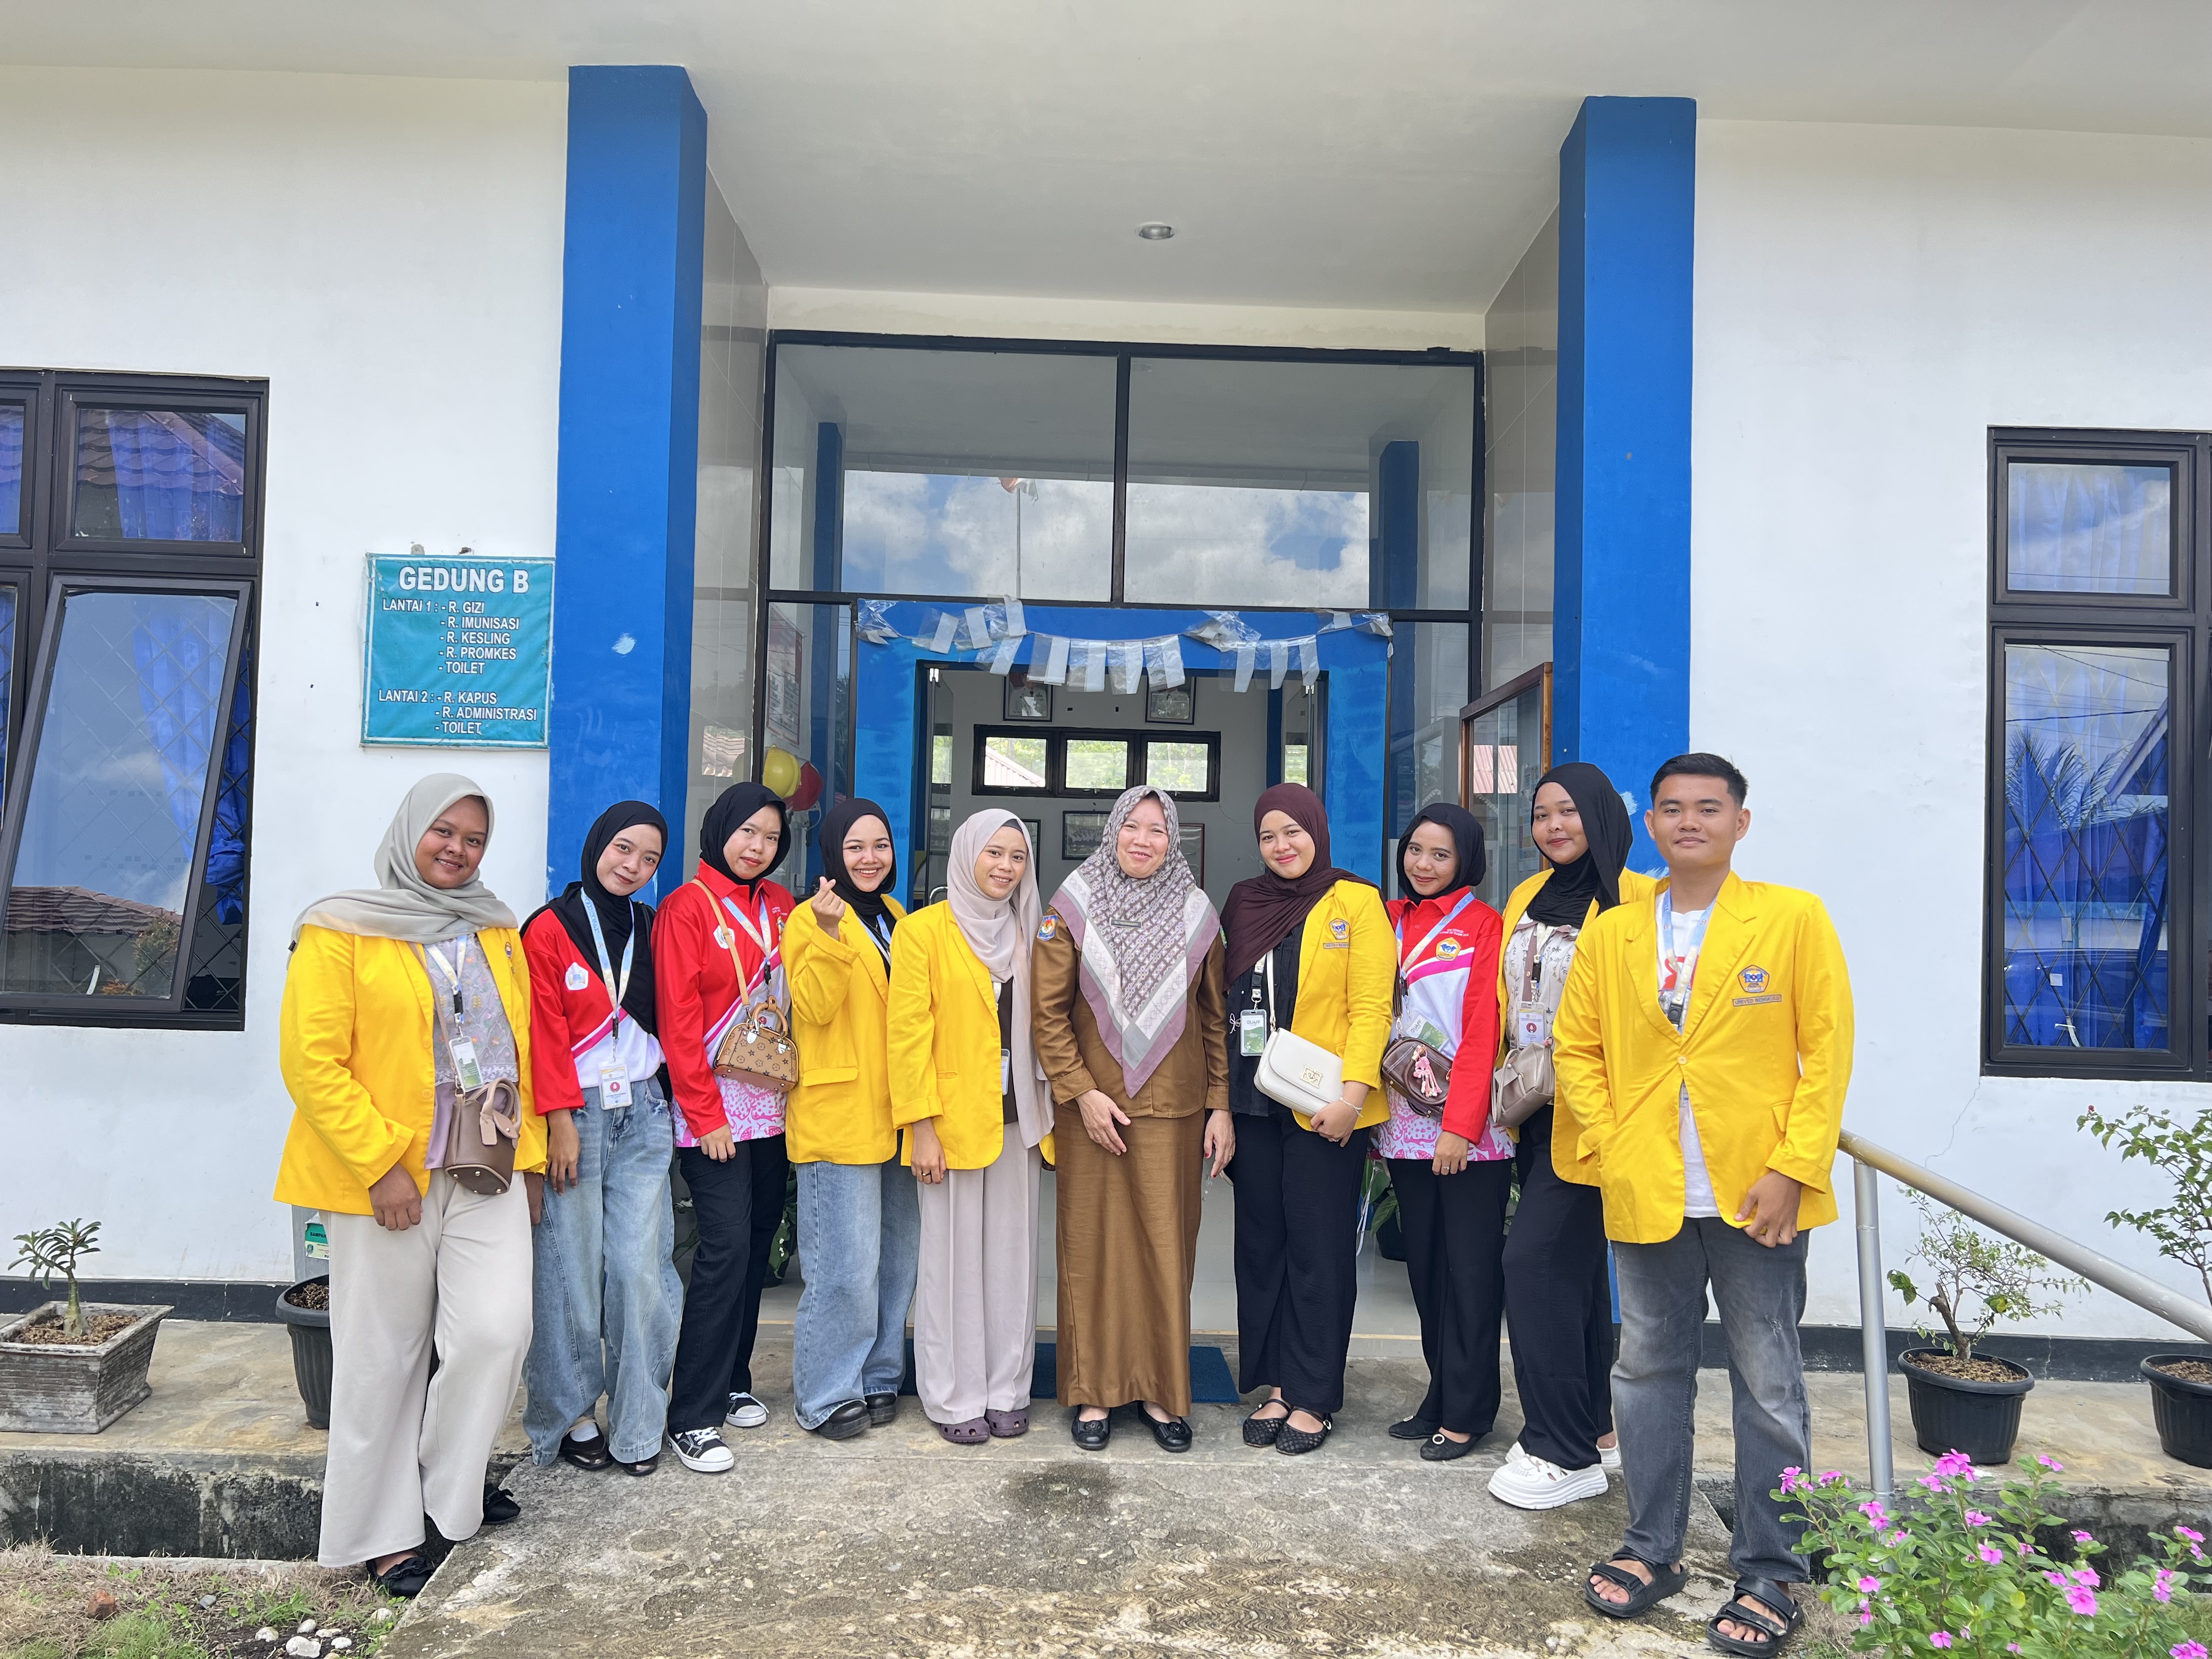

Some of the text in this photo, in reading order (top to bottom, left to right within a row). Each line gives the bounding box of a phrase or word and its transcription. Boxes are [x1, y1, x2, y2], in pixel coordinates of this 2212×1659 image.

[399, 566, 529, 593] GEDUNG B
[383, 599, 422, 612] LANTAI
[426, 600, 431, 612] 1
[449, 601, 459, 613] R.
[462, 601, 484, 614] GIZI
[448, 616, 459, 628] R.
[462, 617, 519, 630] IMUNISASI
[447, 631, 458, 643] R.
[461, 631, 510, 645] KESLING
[446, 646, 457, 658] R.
[460, 646, 516, 660] PROMKES
[445, 661, 485, 674] TOILET
[379, 689, 418, 702] LANTAI
[421, 691, 428, 702] 2
[444, 691, 455, 703] R.
[458, 691, 497, 704] KAPUS
[443, 706, 454, 718] R.
[456, 707, 537, 721] ADMINISTRASI
[442, 721, 482, 735] TOILET
